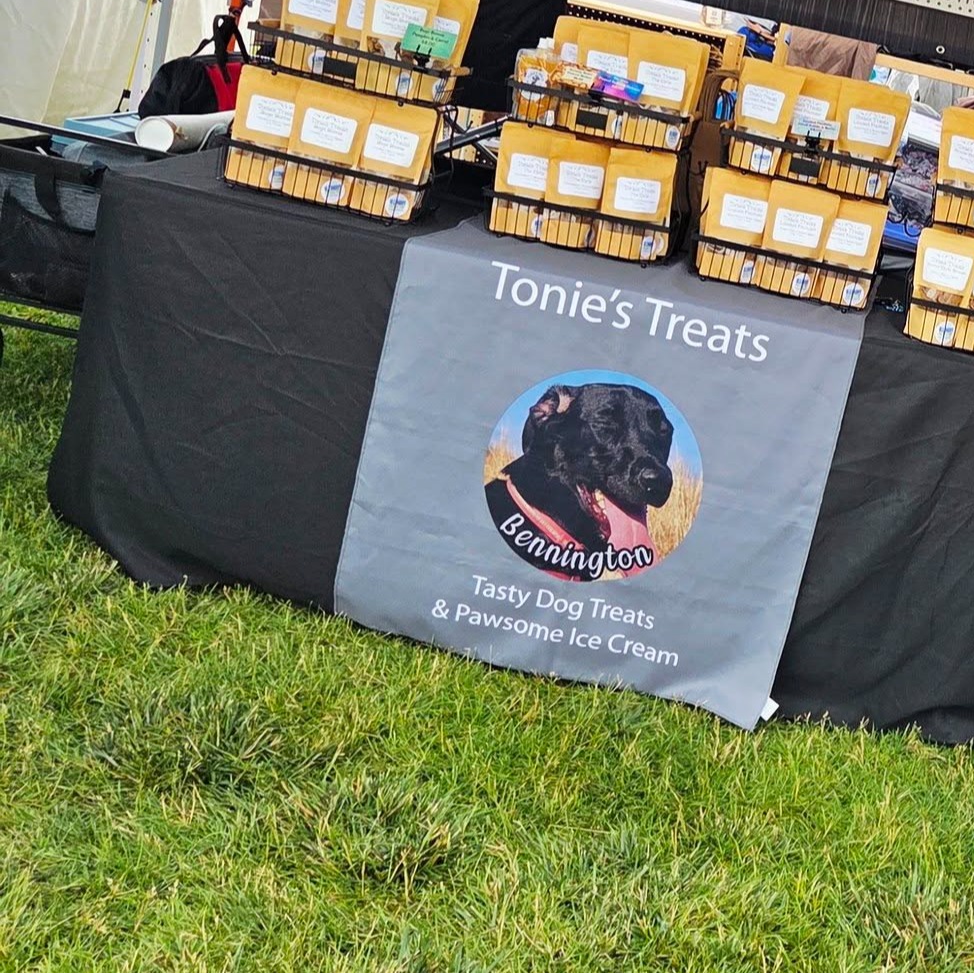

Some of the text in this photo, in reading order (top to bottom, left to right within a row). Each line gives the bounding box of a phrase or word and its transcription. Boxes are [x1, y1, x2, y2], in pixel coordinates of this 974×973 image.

[491, 260, 770, 362] Tonie's Treats
[500, 513, 653, 578] Bennington
[431, 598, 679, 667] & Pawsome Ice Cream
[472, 575, 655, 630] Tasty Dog Treats
